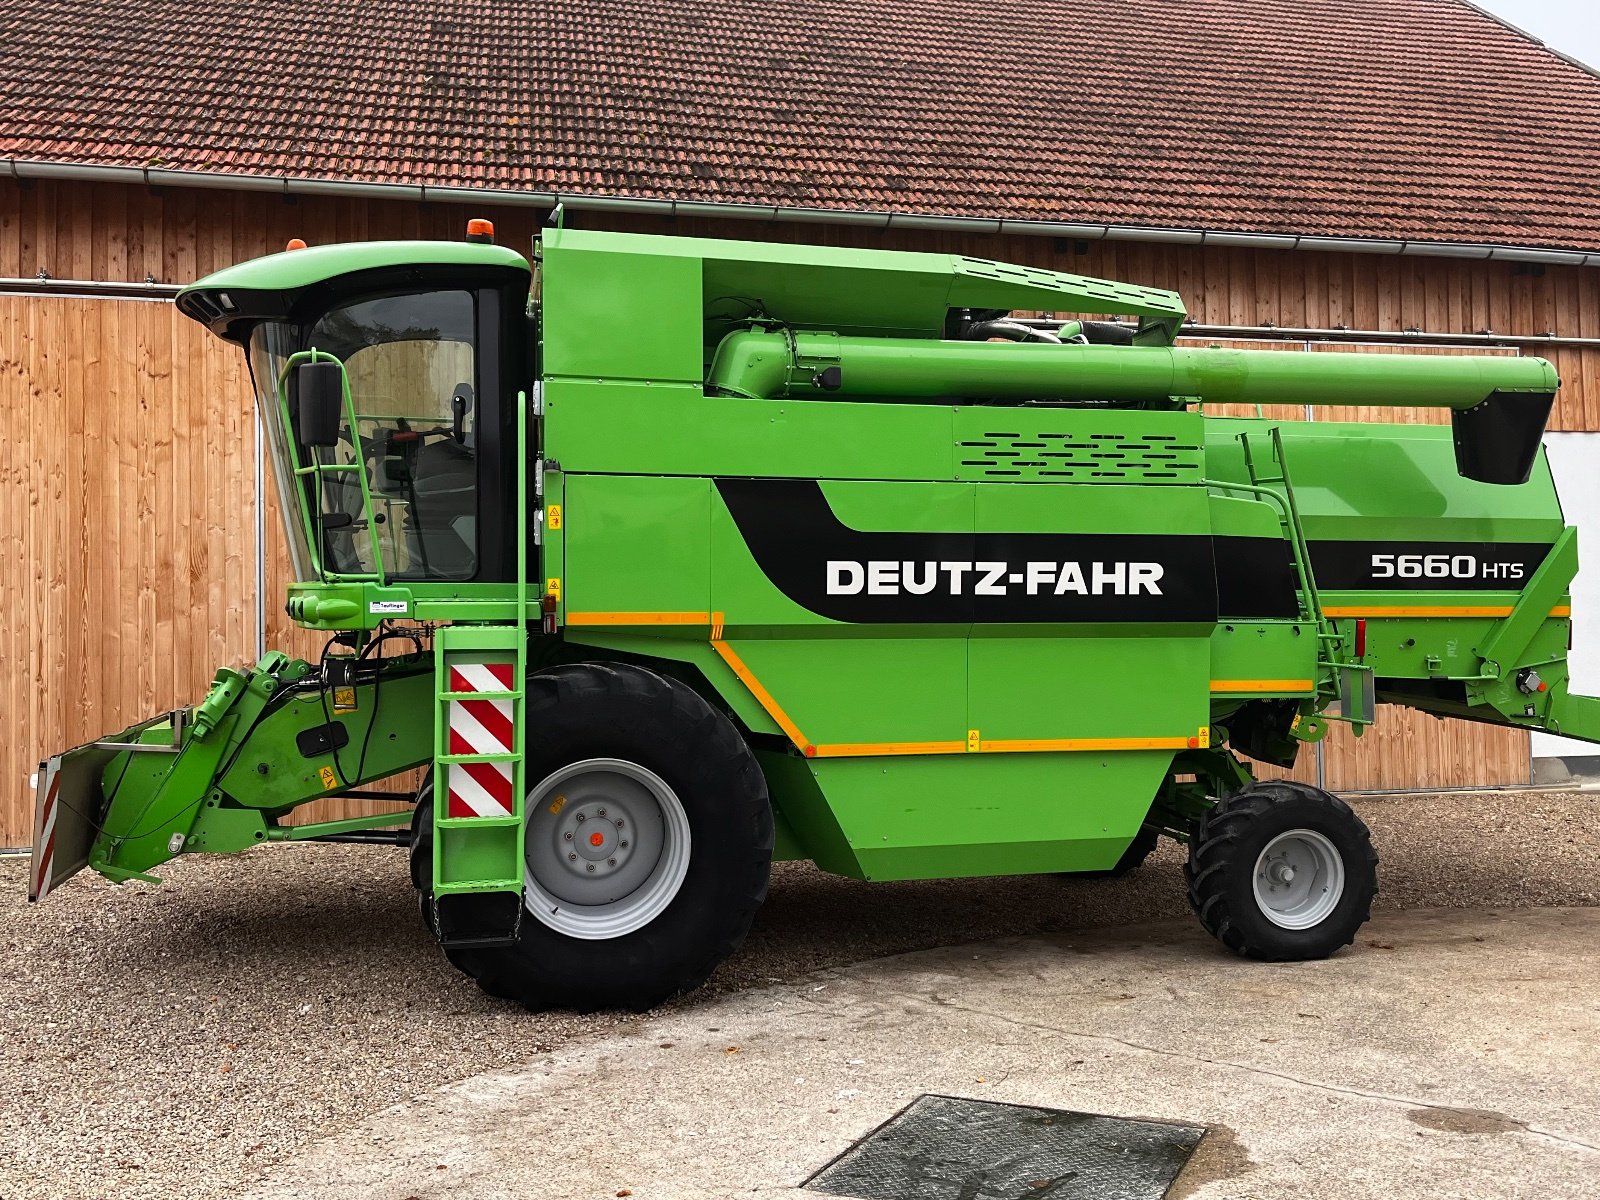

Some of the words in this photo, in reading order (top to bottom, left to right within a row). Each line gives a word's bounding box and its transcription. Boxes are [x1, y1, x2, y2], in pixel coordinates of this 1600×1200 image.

[826, 560, 1164, 595] DEUTZ-FAHR
[1371, 554, 1477, 578] 5660
[1482, 562, 1524, 579] HTS
